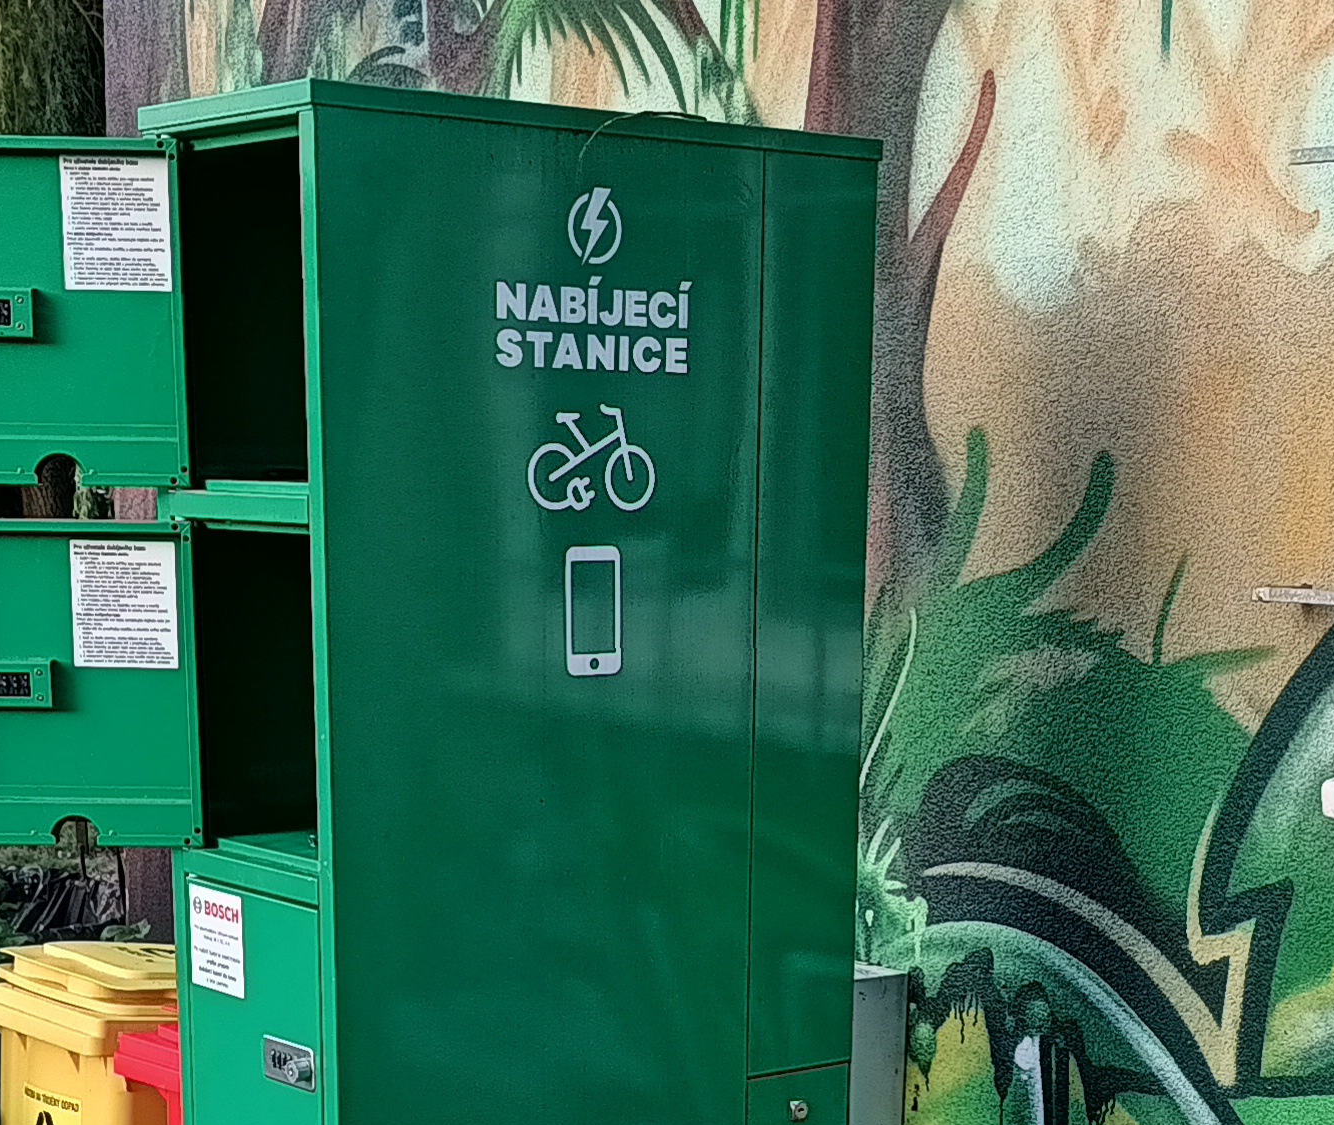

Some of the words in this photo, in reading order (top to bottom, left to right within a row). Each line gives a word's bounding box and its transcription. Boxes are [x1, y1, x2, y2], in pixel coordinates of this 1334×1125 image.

[496, 276, 692, 329] NABÍJECÍ
[496, 329, 687, 373] STANICE
[204, 900, 239, 924] BOSCH
